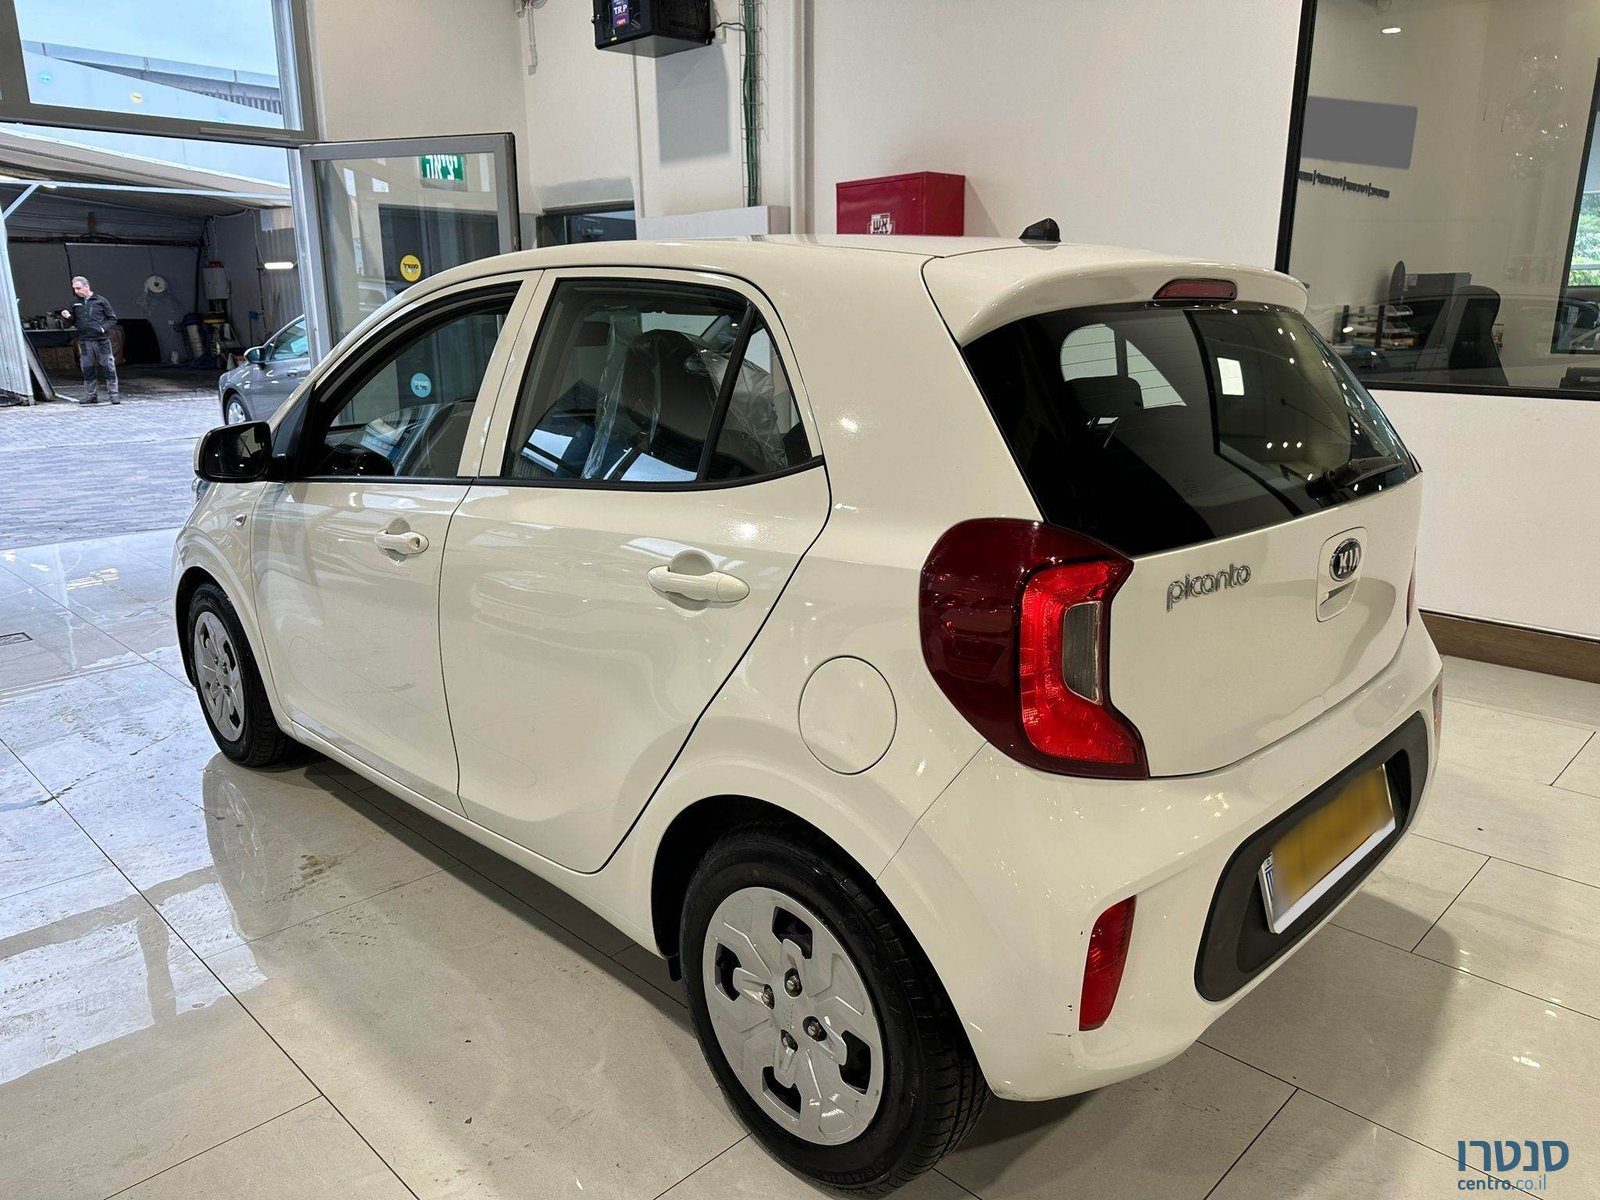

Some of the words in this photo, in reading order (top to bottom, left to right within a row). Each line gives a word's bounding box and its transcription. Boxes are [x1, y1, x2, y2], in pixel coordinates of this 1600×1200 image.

[613, 4, 628, 15] TRP
[425, 154, 458, 180] יציאה
[1337, 546, 1360, 575] KIA
[1166, 563, 1251, 613] picanto
